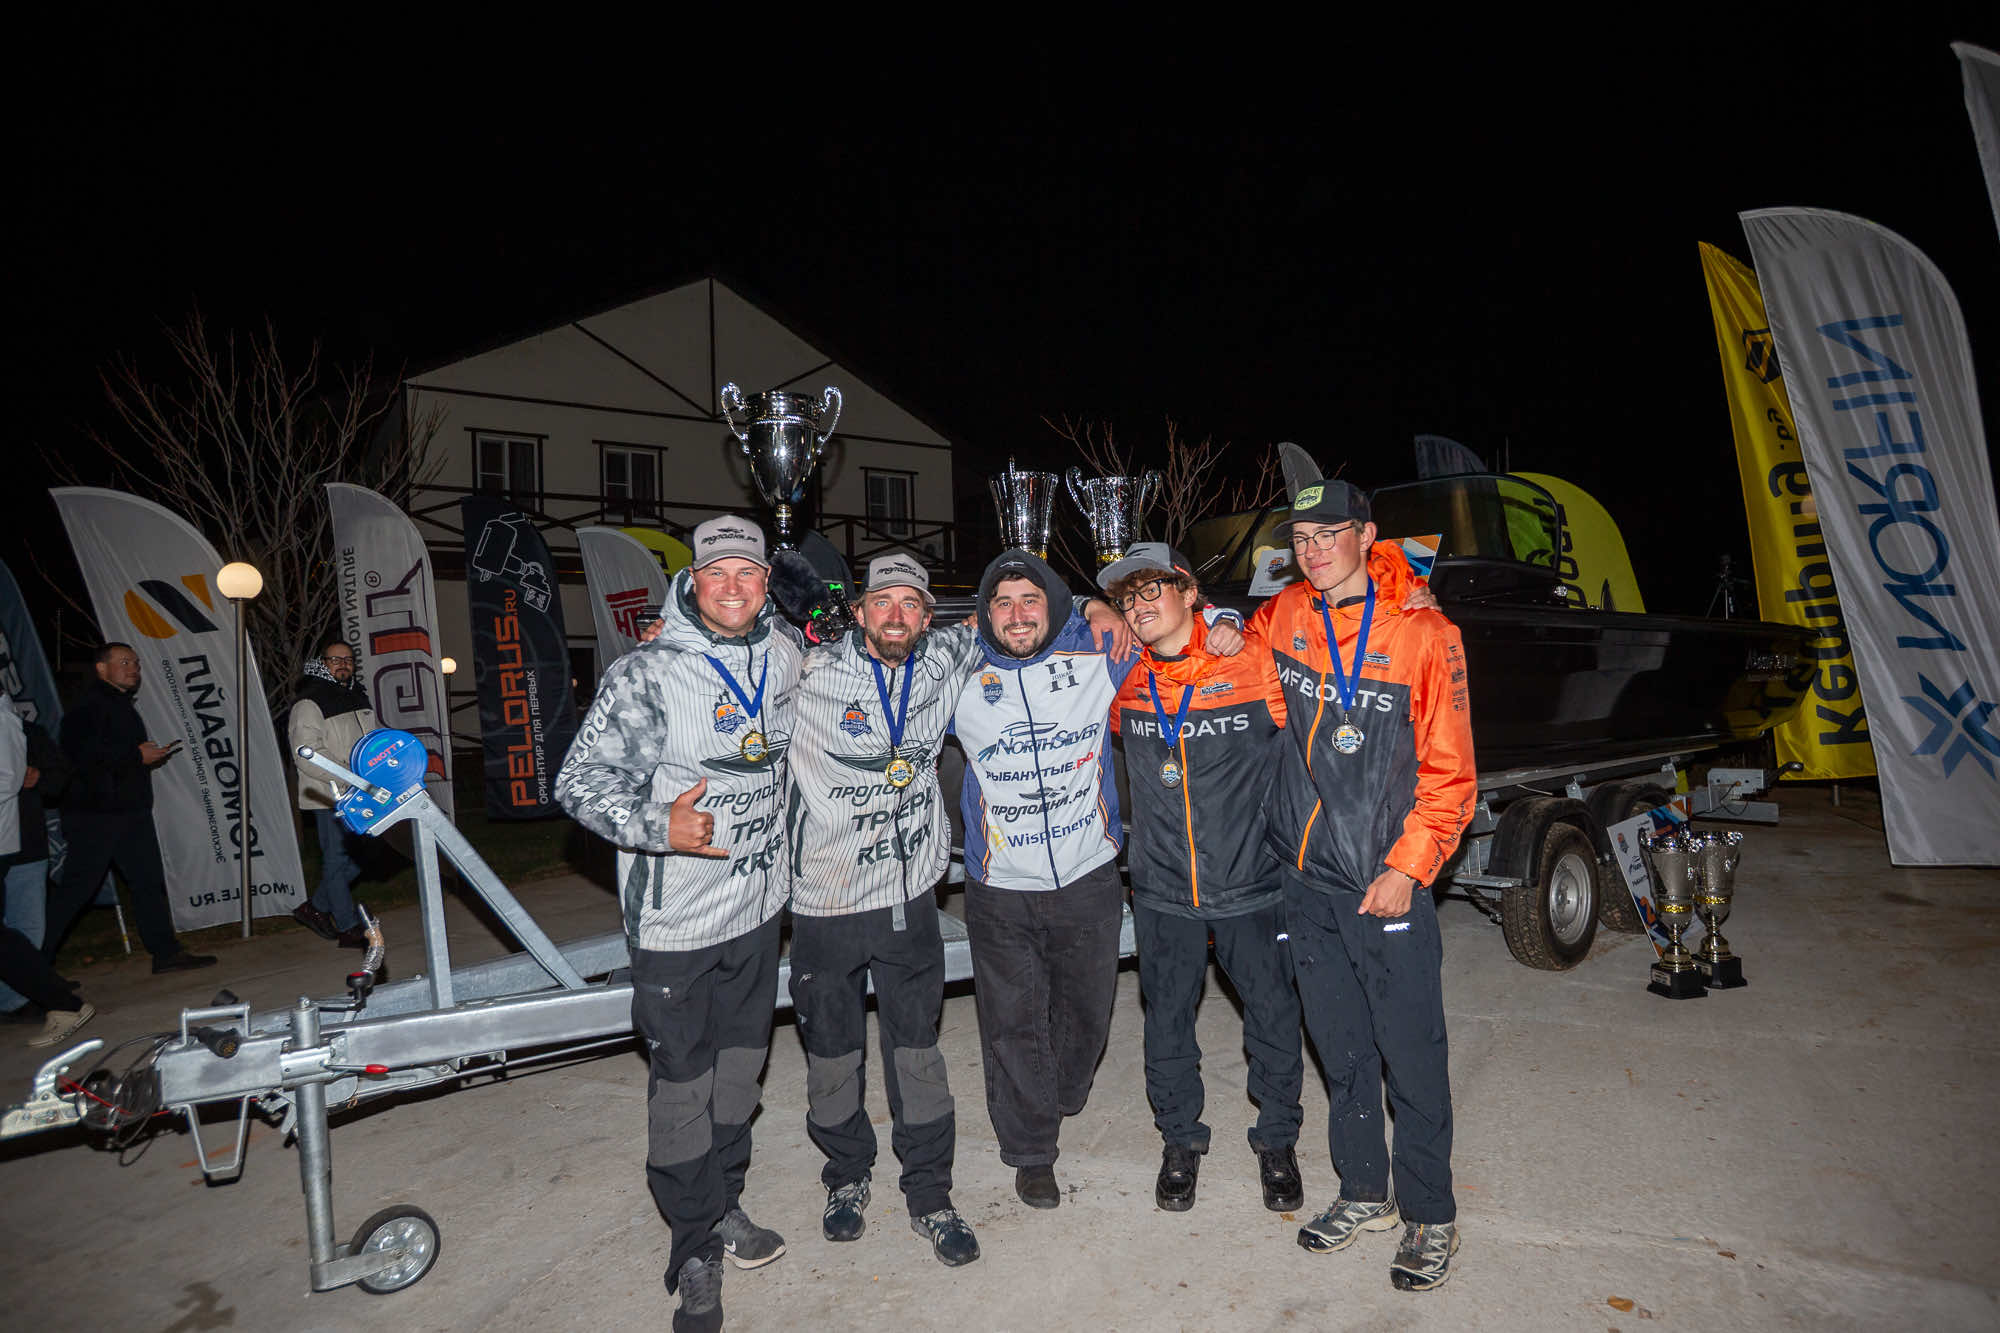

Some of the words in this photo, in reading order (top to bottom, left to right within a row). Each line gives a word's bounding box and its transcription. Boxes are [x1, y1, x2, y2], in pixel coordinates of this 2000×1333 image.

[493, 588, 537, 807] PELORUS.RU
[526, 669, 541, 716] ПЕРВЫХ
[532, 718, 544, 743] ДЛЯ
[535, 745, 550, 805] ОРИЕНТИР
